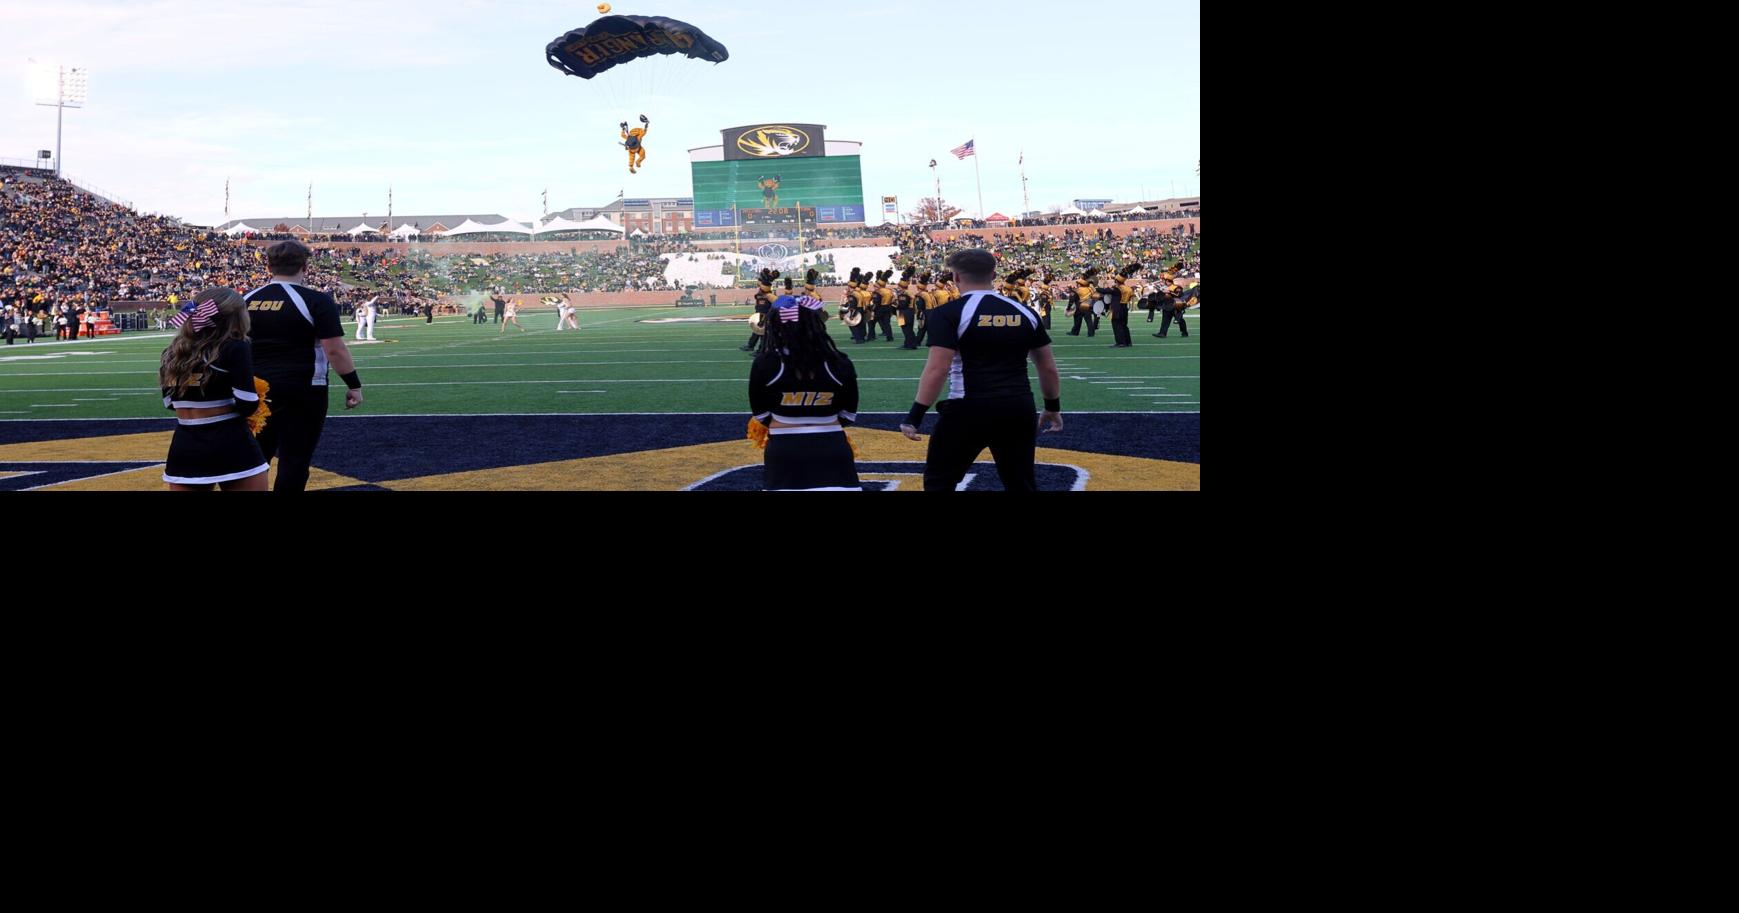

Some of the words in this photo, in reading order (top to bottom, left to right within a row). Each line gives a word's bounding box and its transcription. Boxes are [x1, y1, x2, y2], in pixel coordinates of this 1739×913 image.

[247, 300, 284, 311] ZOU
[977, 314, 1022, 327] ZOU
[780, 391, 834, 406] MIZ
